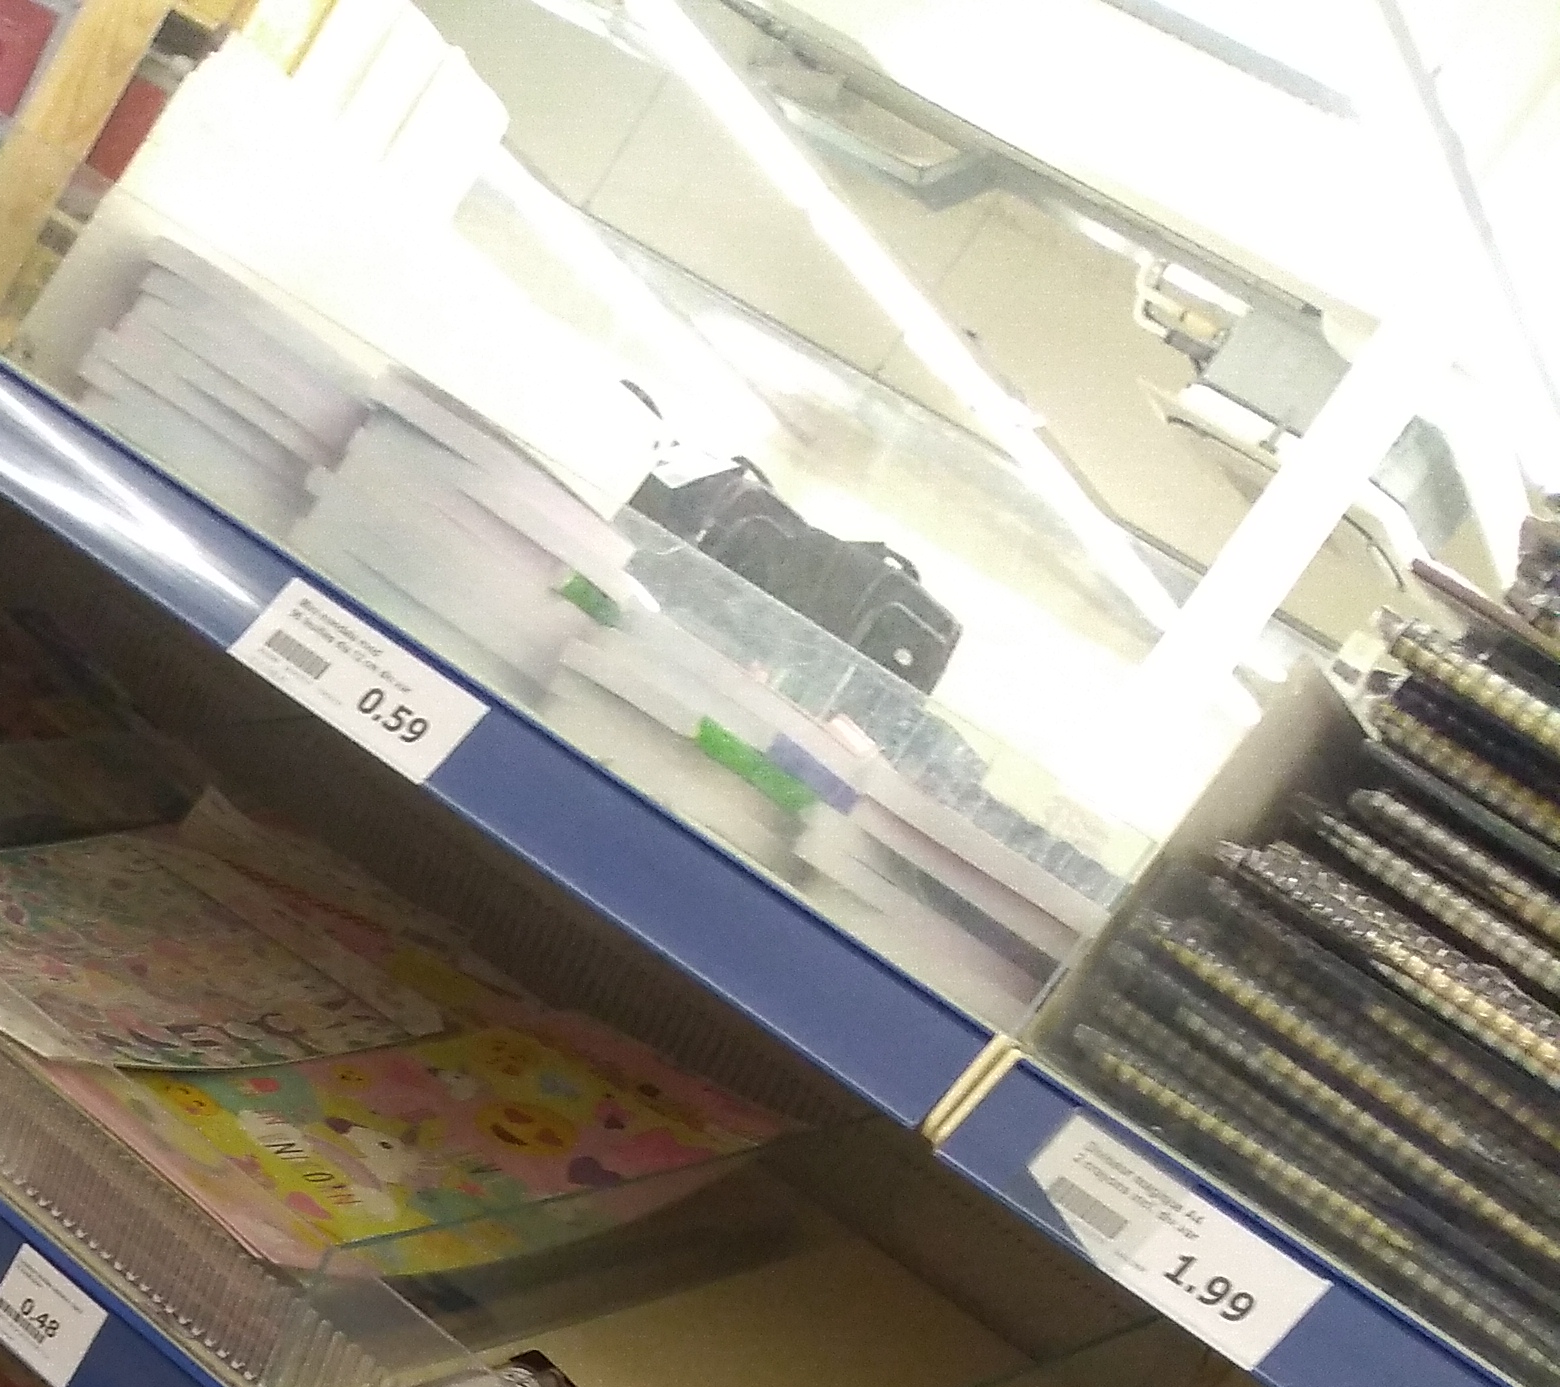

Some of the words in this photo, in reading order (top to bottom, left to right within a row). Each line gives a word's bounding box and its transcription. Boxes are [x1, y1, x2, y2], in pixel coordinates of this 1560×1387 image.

[353, 685, 432, 747] 0.59
[19, 1295, 61, 1339] 0.48
[1161, 1252, 1258, 1327] 1.99
